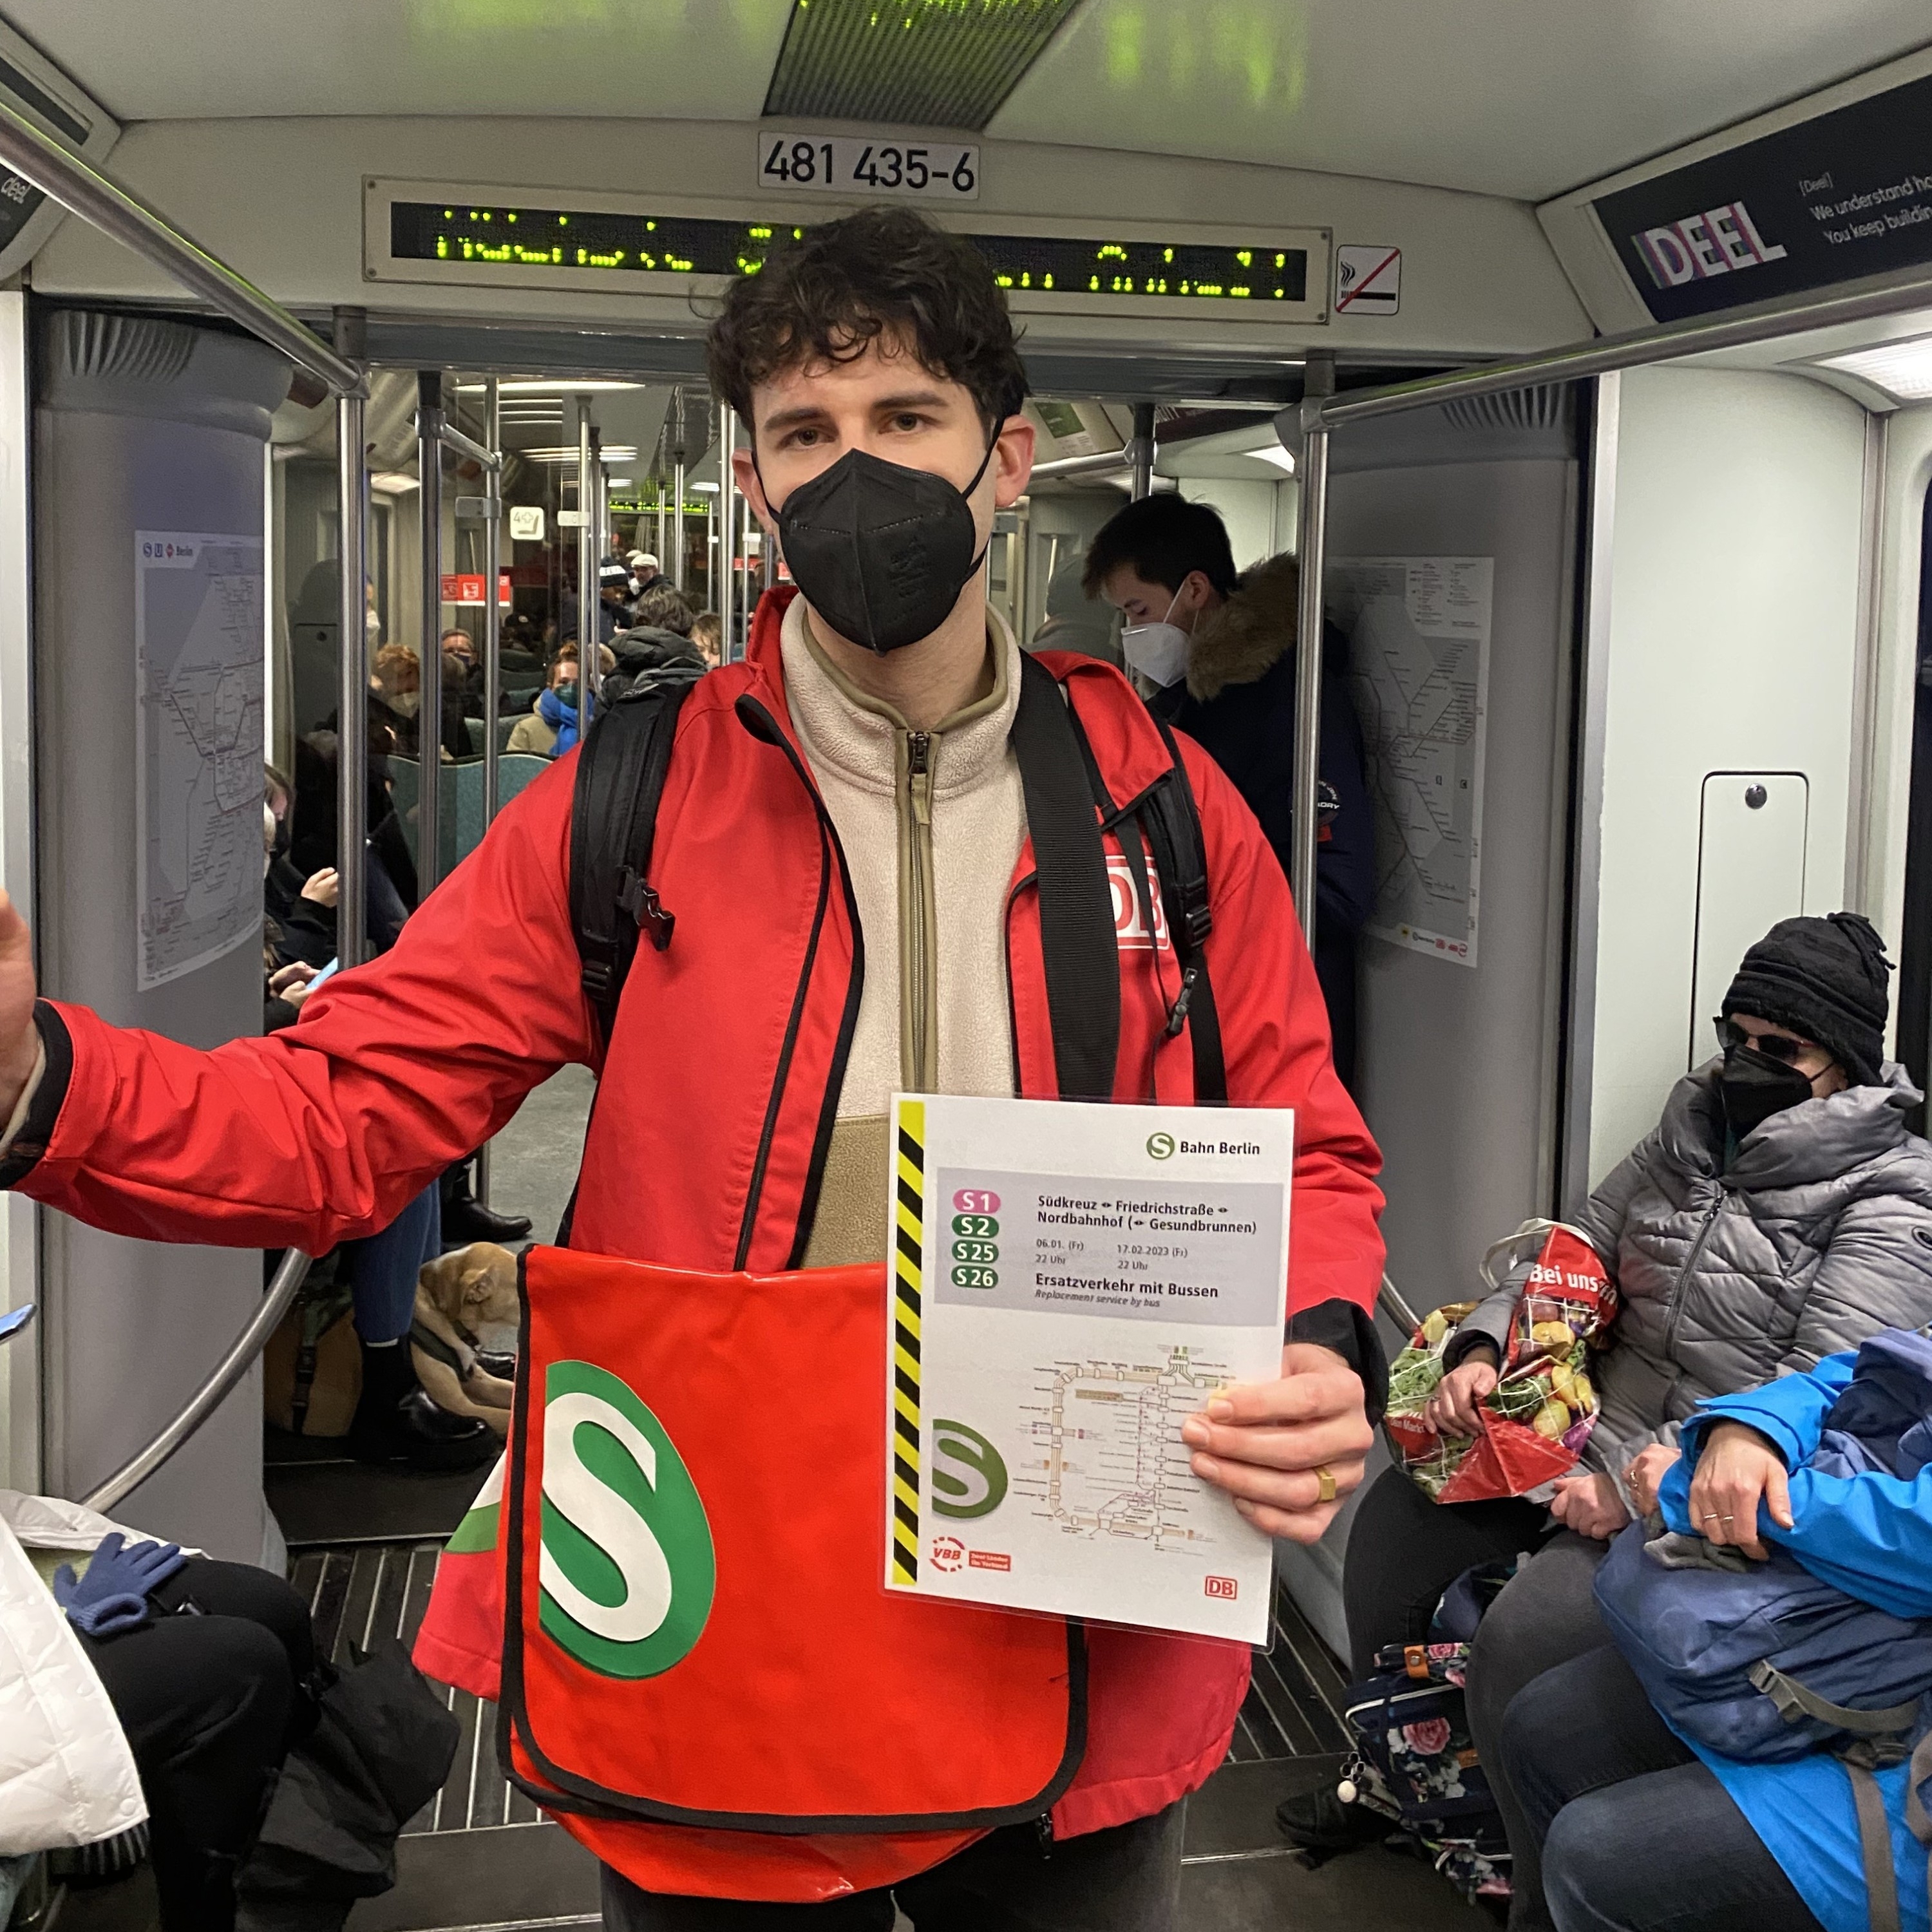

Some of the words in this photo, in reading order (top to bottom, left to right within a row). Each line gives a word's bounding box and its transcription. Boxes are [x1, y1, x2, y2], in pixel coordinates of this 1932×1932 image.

[764, 139, 833, 184] 481
[853, 146, 974, 192] 435-6
[1810, 205, 1834, 220] We
[1834, 177, 1914, 214] understand
[1823, 229, 1851, 244] You
[1849, 220, 1886, 238] keep
[1643, 200, 1788, 286] DEEL
[1180, 1141, 1215, 1155] Bahn
[1218, 1142, 1260, 1155] Berlin
[1037, 1195, 1097, 1211] Südkreuz
[1115, 1200, 1214, 1217] Friedrichstraße
[1037, 1211, 1123, 1229] Nordbahnhof
[1117, 1244, 1170, 1256] 17.02.2023
[1049, 1255, 1066, 1265] Uhr
[1118, 1260, 1130, 1270] 22
[1132, 1260, 1148, 1271] Uhr
[1036, 1273, 1136, 1293] Ersatzverkehr
[1139, 1281, 1164, 1295] mit
[1168, 1283, 1218, 1298] Bussen
[1530, 1264, 1563, 1285] Bei
[1566, 1272, 1598, 1293] uns
[1035, 1290, 1095, 1303] Replacement
[1095, 1295, 1128, 1305] service
[1129, 1296, 1142, 1307] by
[1143, 1298, 1160, 1308] bus
[933, 1548, 961, 1560] VBB
[1209, 1580, 1233, 1597] DB
